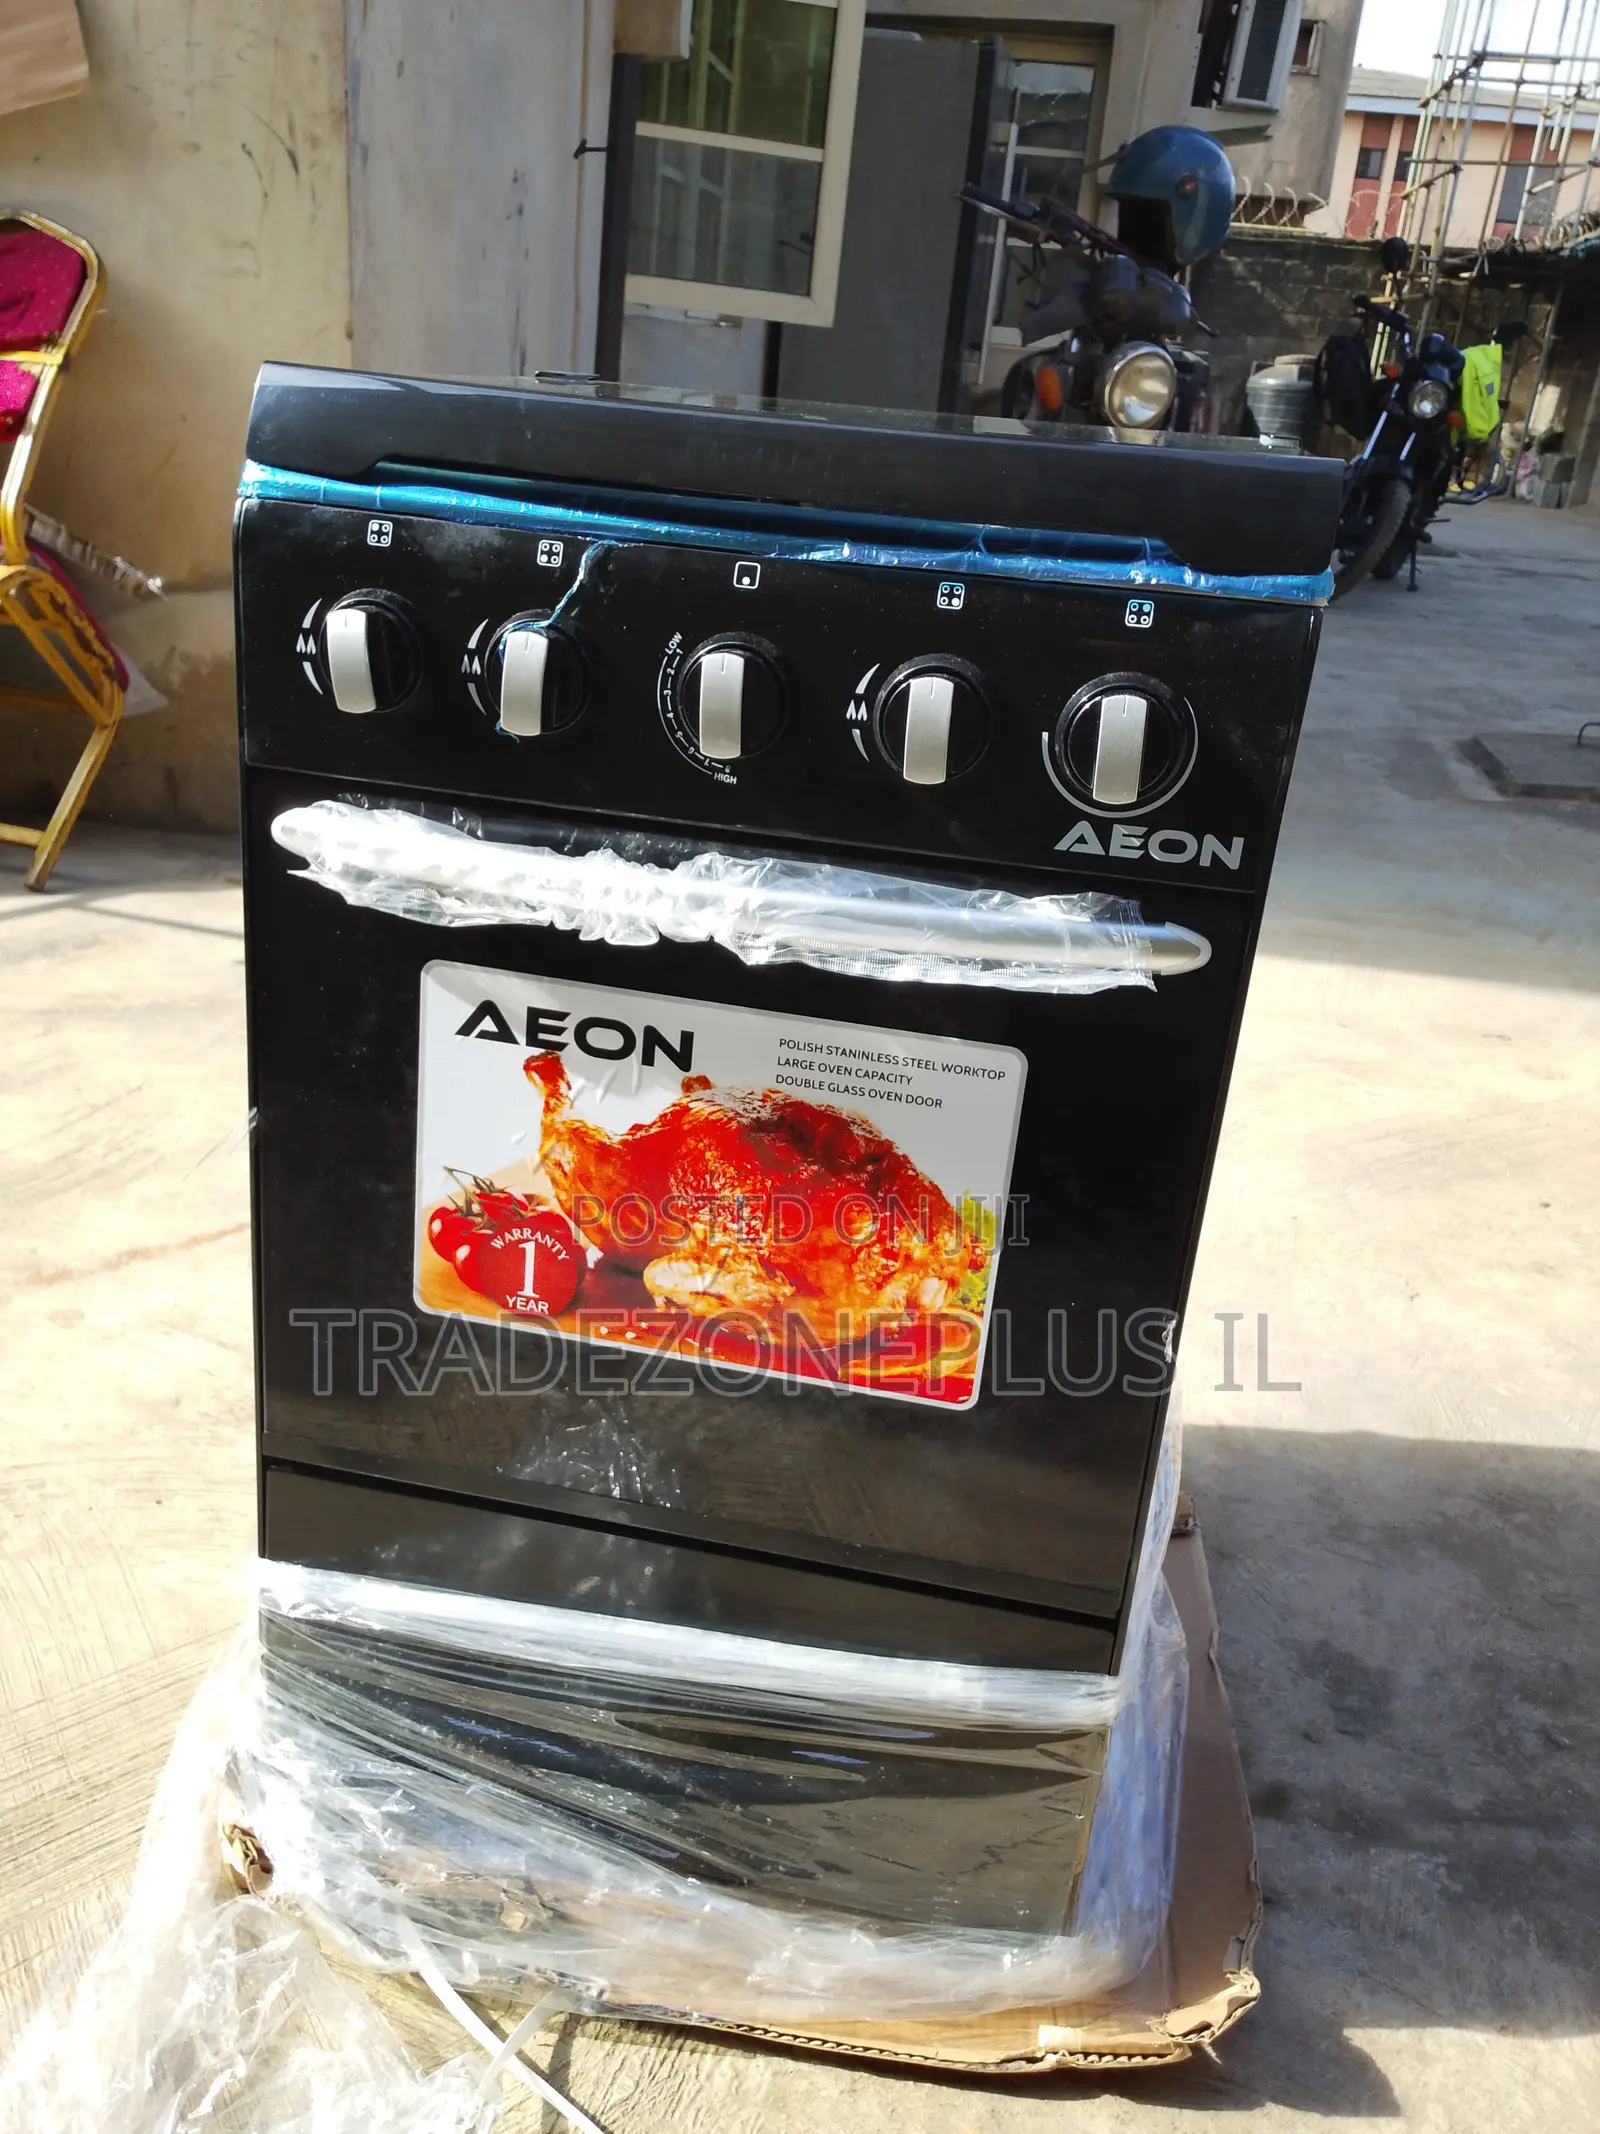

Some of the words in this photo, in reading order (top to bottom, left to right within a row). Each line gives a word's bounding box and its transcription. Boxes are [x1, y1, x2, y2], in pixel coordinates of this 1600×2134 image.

[664, 631, 683, 656] LOW
[667, 668, 675, 676] 2
[663, 689, 672, 697] 3
[666, 711, 674, 719] 4
[675, 730, 683, 739] 5
[713, 771, 738, 785] HIGH
[1053, 820, 1245, 870] AEON
[454, 999, 695, 1073] AEON
[777, 1056, 816, 1071] LARGE
[818, 1062, 852, 1076] OVEN
[855, 1068, 913, 1085] CAPACITY
[779, 1038, 823, 1054] POLISH
[825, 1045, 900, 1066] STANINLESS
[901, 1057, 938, 1071] STEEL
[941, 1062, 1006, 1081] WORKTOP
[775, 1074, 825, 1091] DOUBLE
[827, 1082, 865, 1097] GLASS
[868, 1088, 903, 1103] OVEN
[905, 1094, 943, 1109] DOOR
[490, 1227, 570, 1261] WARRANTY
[516, 1240, 540, 1298] 1
[505, 1294, 549, 1315] YEAR
